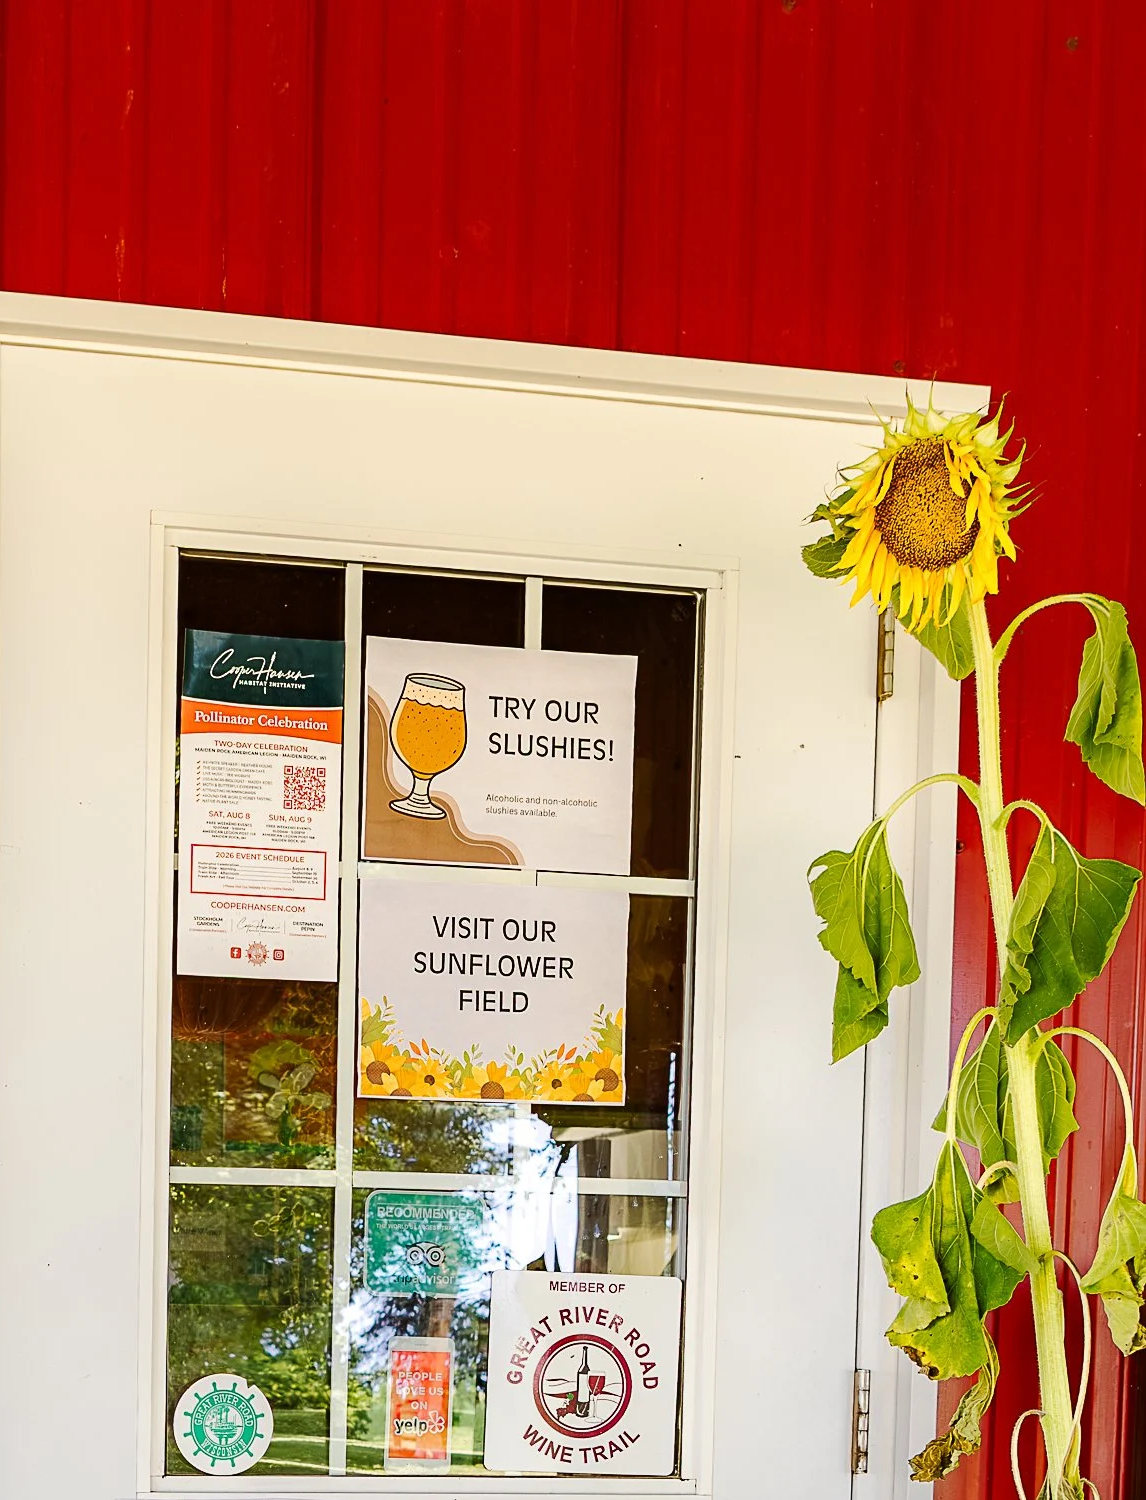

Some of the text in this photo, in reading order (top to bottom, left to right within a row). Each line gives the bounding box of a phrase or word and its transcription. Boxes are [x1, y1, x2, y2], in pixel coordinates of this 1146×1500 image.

[269, 682, 306, 690] INITIATIVE
[489, 696, 599, 724] TRY OUR
[194, 711, 328, 731] Pollinator Celebration
[215, 740, 308, 753] TWO-DAY CELEBRATION
[489, 732, 613, 761] SLUSHIES!
[486, 794, 598, 808] Alcoholic and non-alcoholic
[269, 814, 286, 822] SUN,
[486, 806, 557, 817] slushies available.
[215, 851, 305, 863] 2026 EVENT SCHEDULE
[211, 901, 306, 913] COOPERHANSEN.COM
[432, 916, 556, 942] VISIT OUR
[414, 952, 574, 979] SUNFLOWER
[459, 990, 529, 1013] FIELD
[549, 1281, 625, 1294] MEMBER OF
[507, 1306, 659, 1389] GREAT RIVER ROAD
[398, 1372, 442, 1381] PEOPLE
[396, 1387, 444, 1396] LOVE US
[195, 1394, 253, 1427] GREAT RIVER ROAD
[411, 1401, 428, 1410] ON
[395, 1418, 427, 1434] yelp
[201, 1439, 247, 1456] WISCONSIN
[523, 1424, 640, 1464] WINE TRAIL
